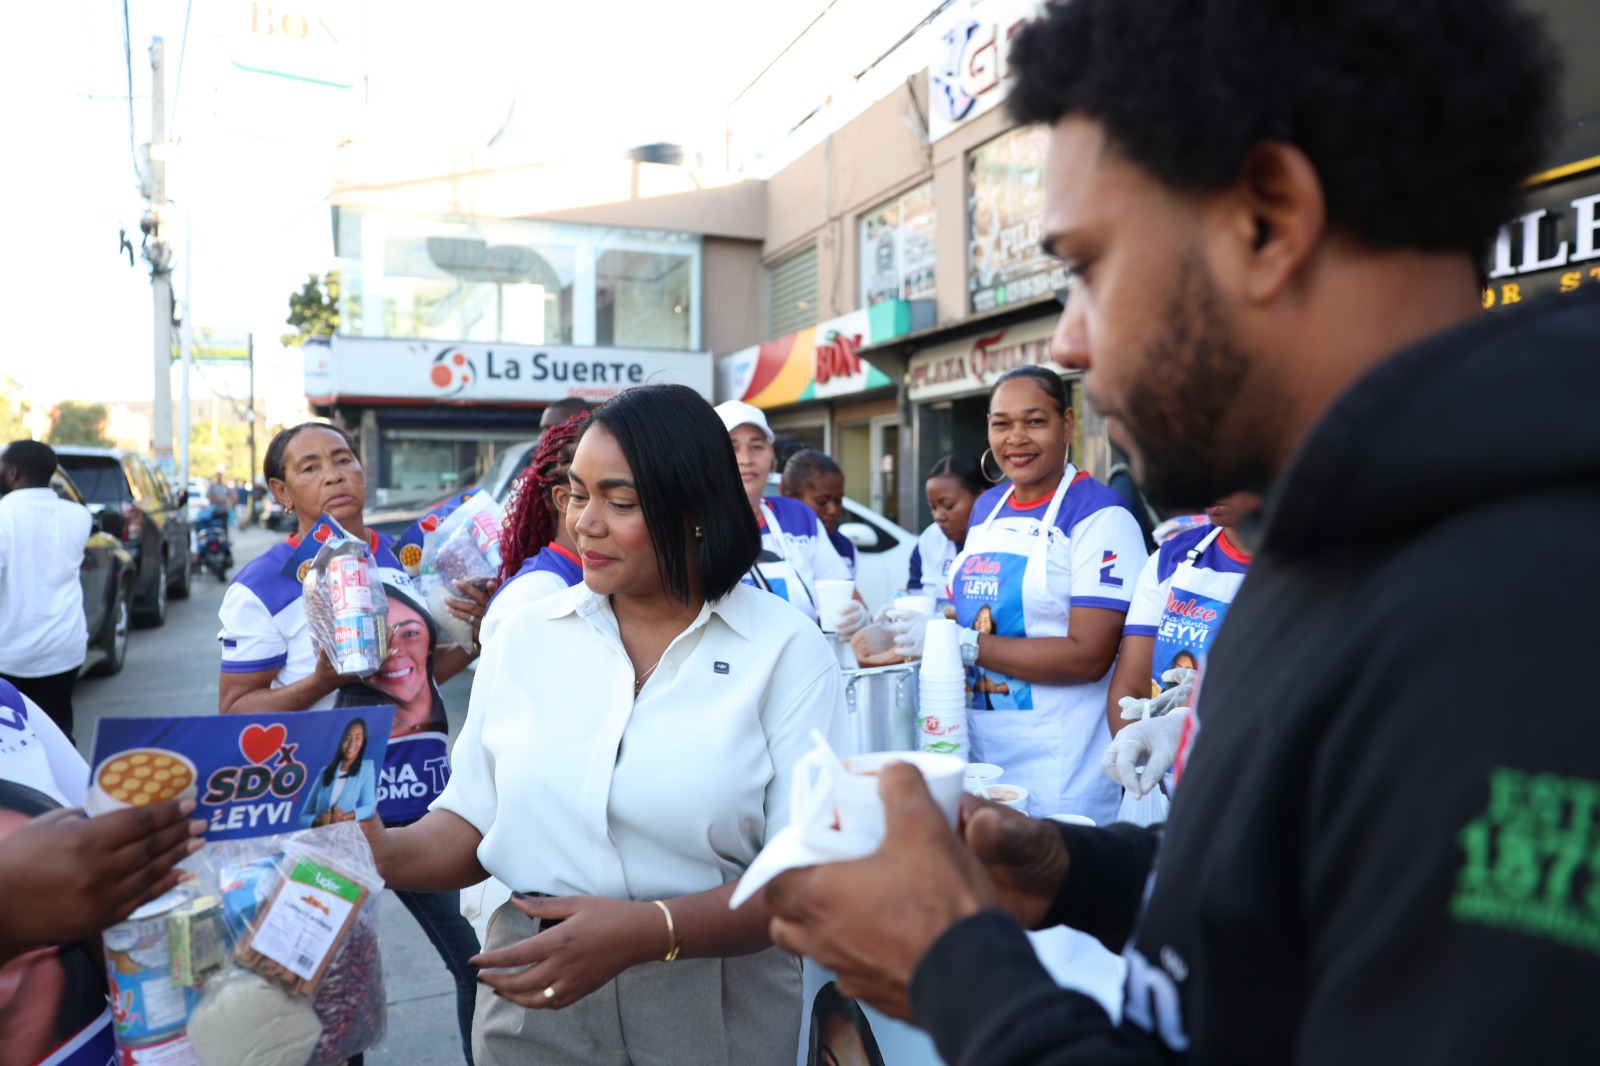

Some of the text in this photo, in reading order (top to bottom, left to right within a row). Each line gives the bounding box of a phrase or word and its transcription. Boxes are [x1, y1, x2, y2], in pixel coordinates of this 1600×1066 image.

[486, 351, 520, 379] La
[910, 357, 967, 389] PLAZA
[201, 761, 307, 806] SDO
[209, 801, 294, 832] LEYVI
